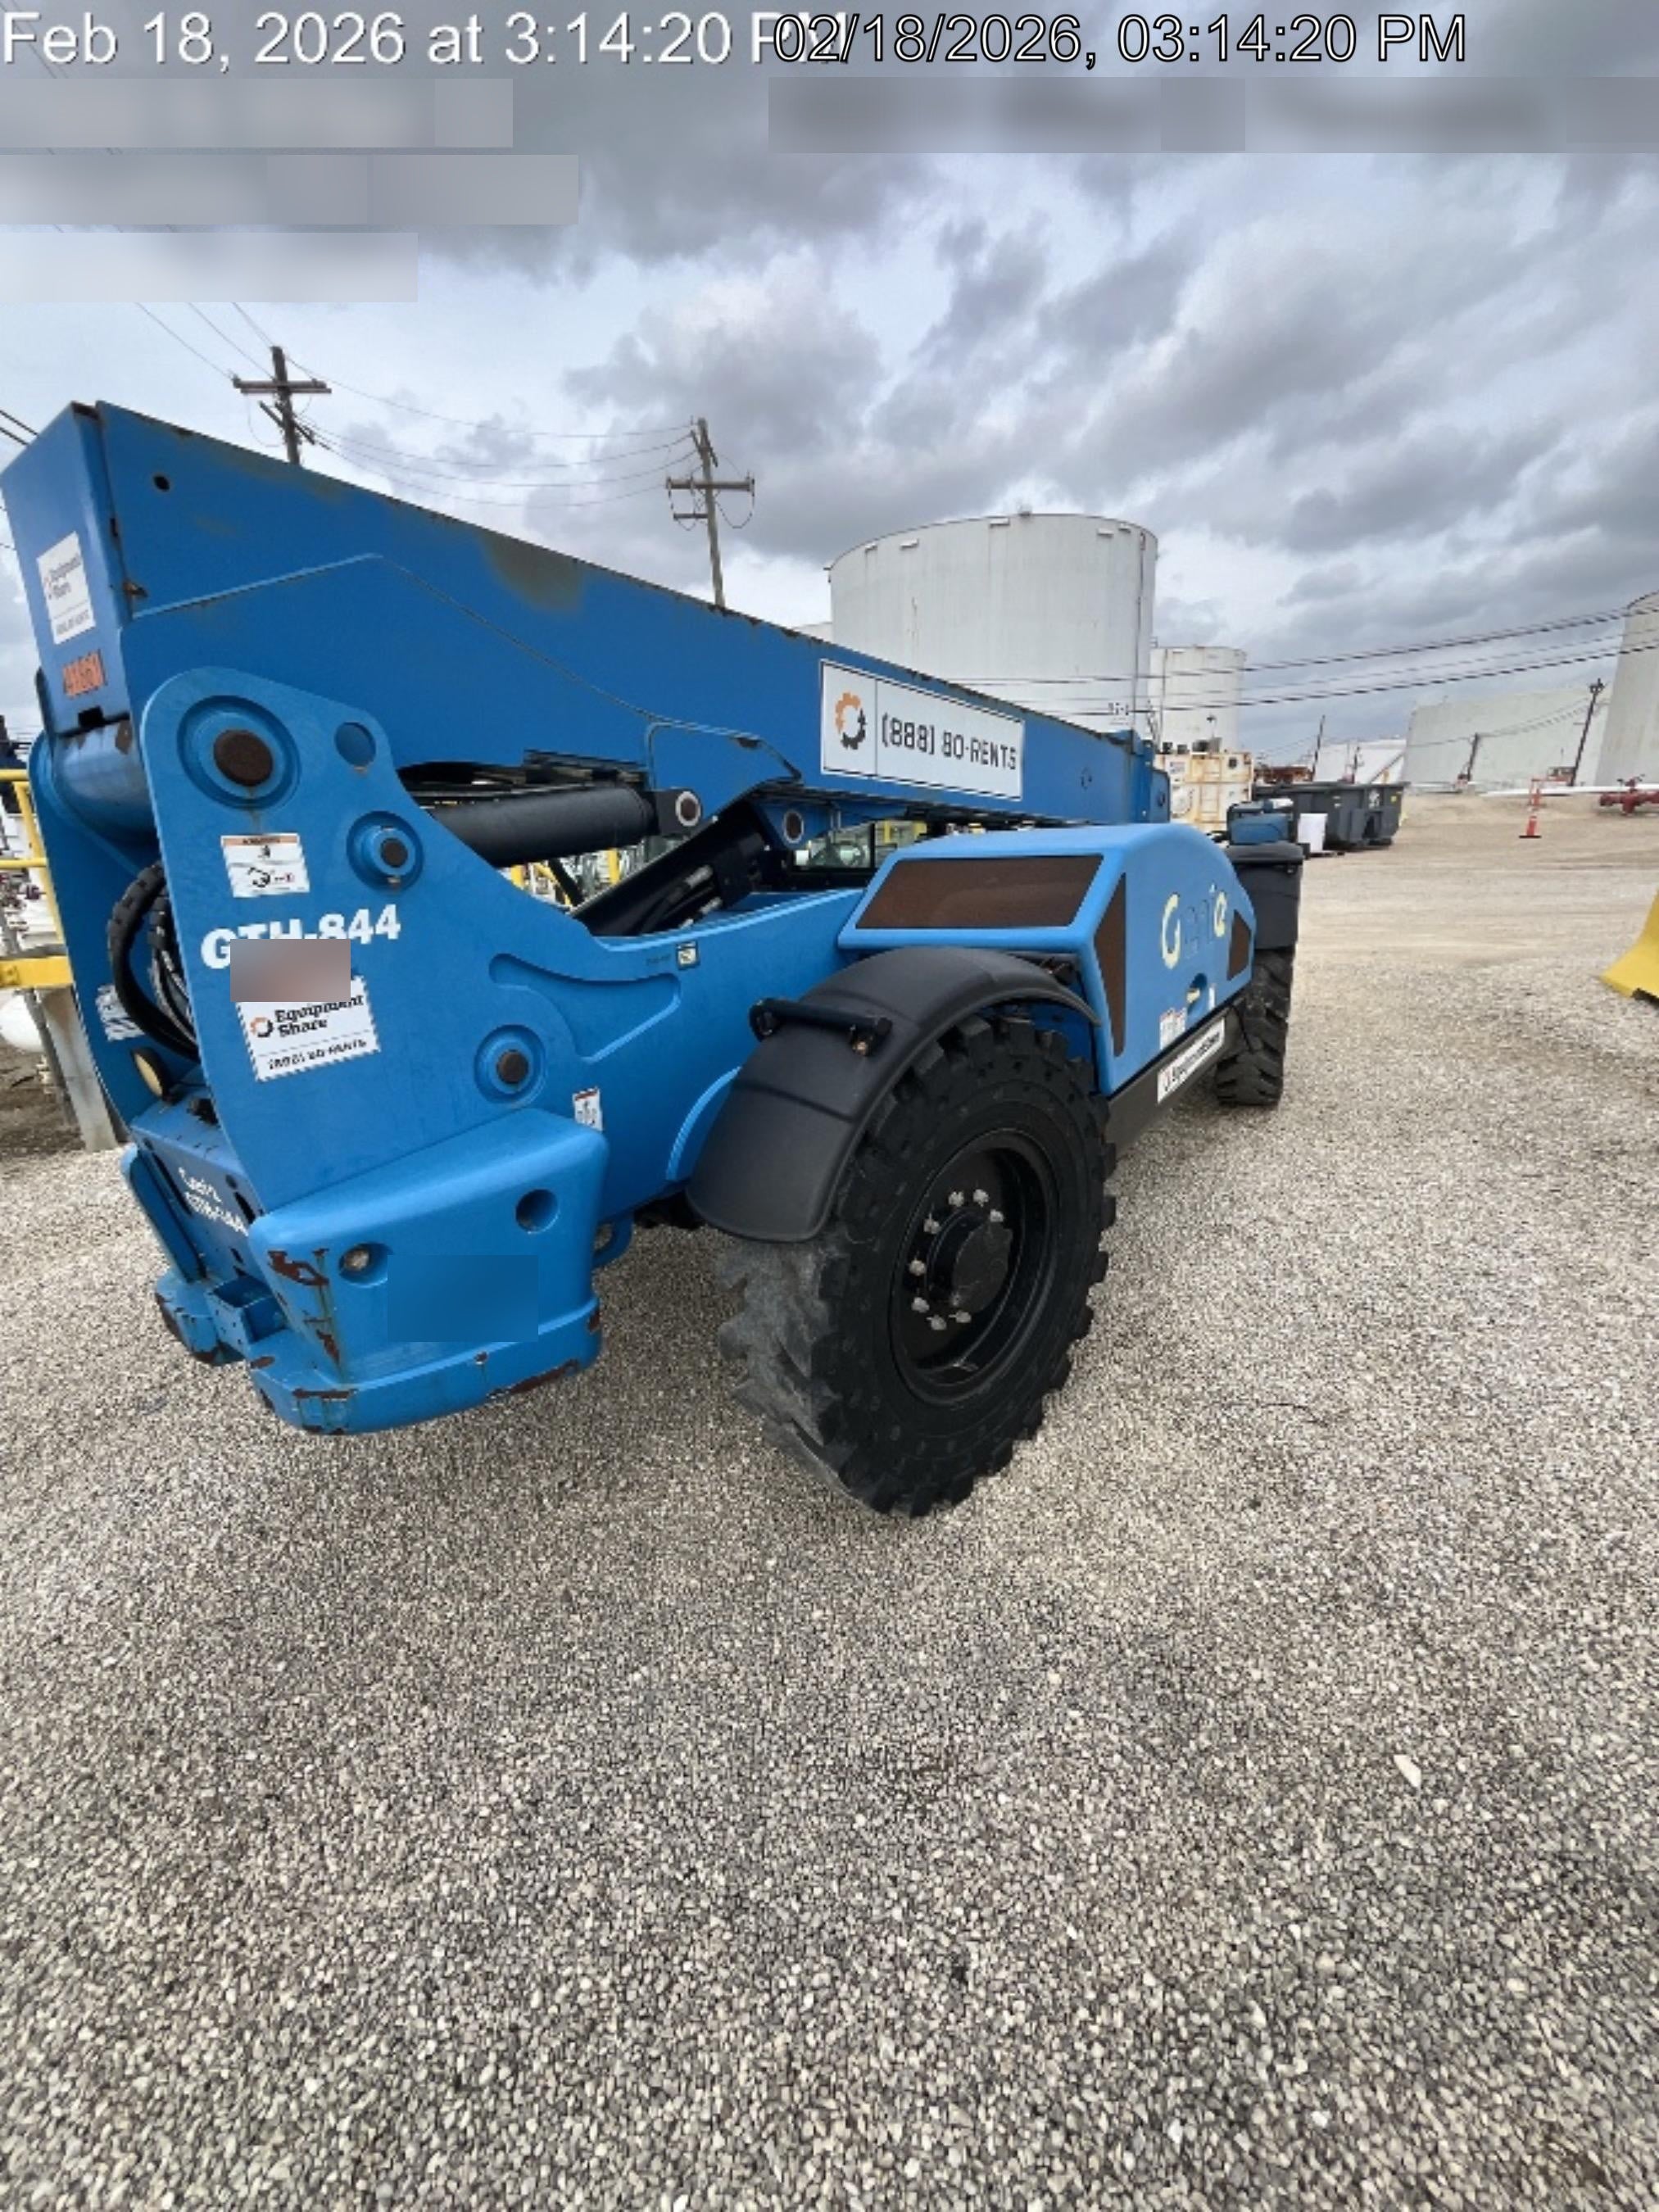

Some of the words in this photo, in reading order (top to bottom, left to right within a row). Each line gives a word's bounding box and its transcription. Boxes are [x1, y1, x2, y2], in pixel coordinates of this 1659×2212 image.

[882, 712, 935, 755] (888)
[941, 730, 1016, 770] 80-RENTS
[278, 1018, 328, 1037] Share
